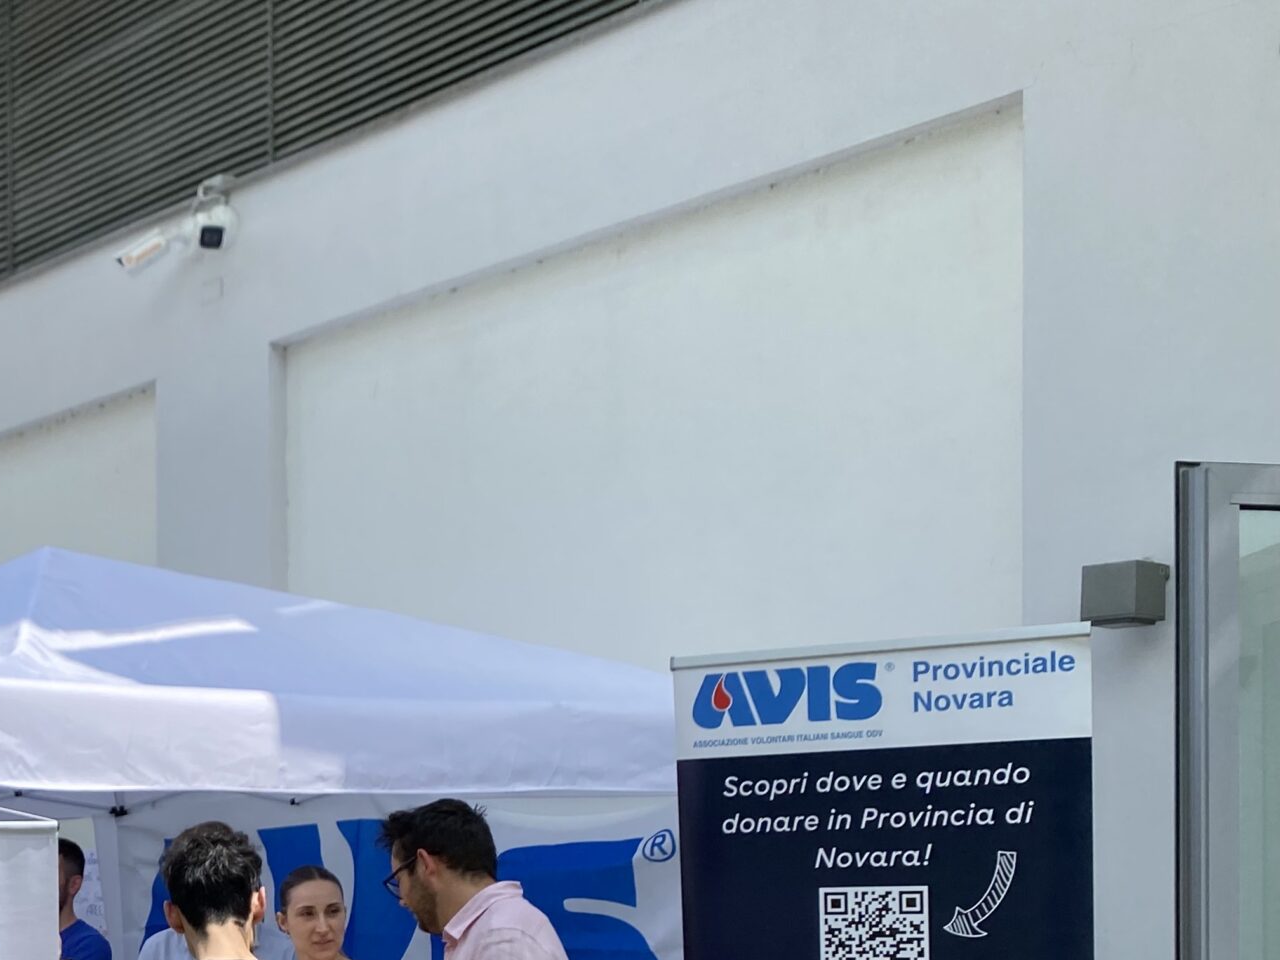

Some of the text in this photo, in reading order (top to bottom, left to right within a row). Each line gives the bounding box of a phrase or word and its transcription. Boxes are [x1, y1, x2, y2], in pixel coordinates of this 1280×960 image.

[913, 650, 1076, 682] Provinciale
[913, 686, 1014, 713] Novara
[693, 729, 883, 748] ASSOCIAZIONE VOLONTARI ITALIANI SANGUE ODV
[723, 763, 1031, 801] Scopri dove e quando
[722, 800, 1035, 835] donare in Provincia di
[814, 843, 933, 869] Novara!
